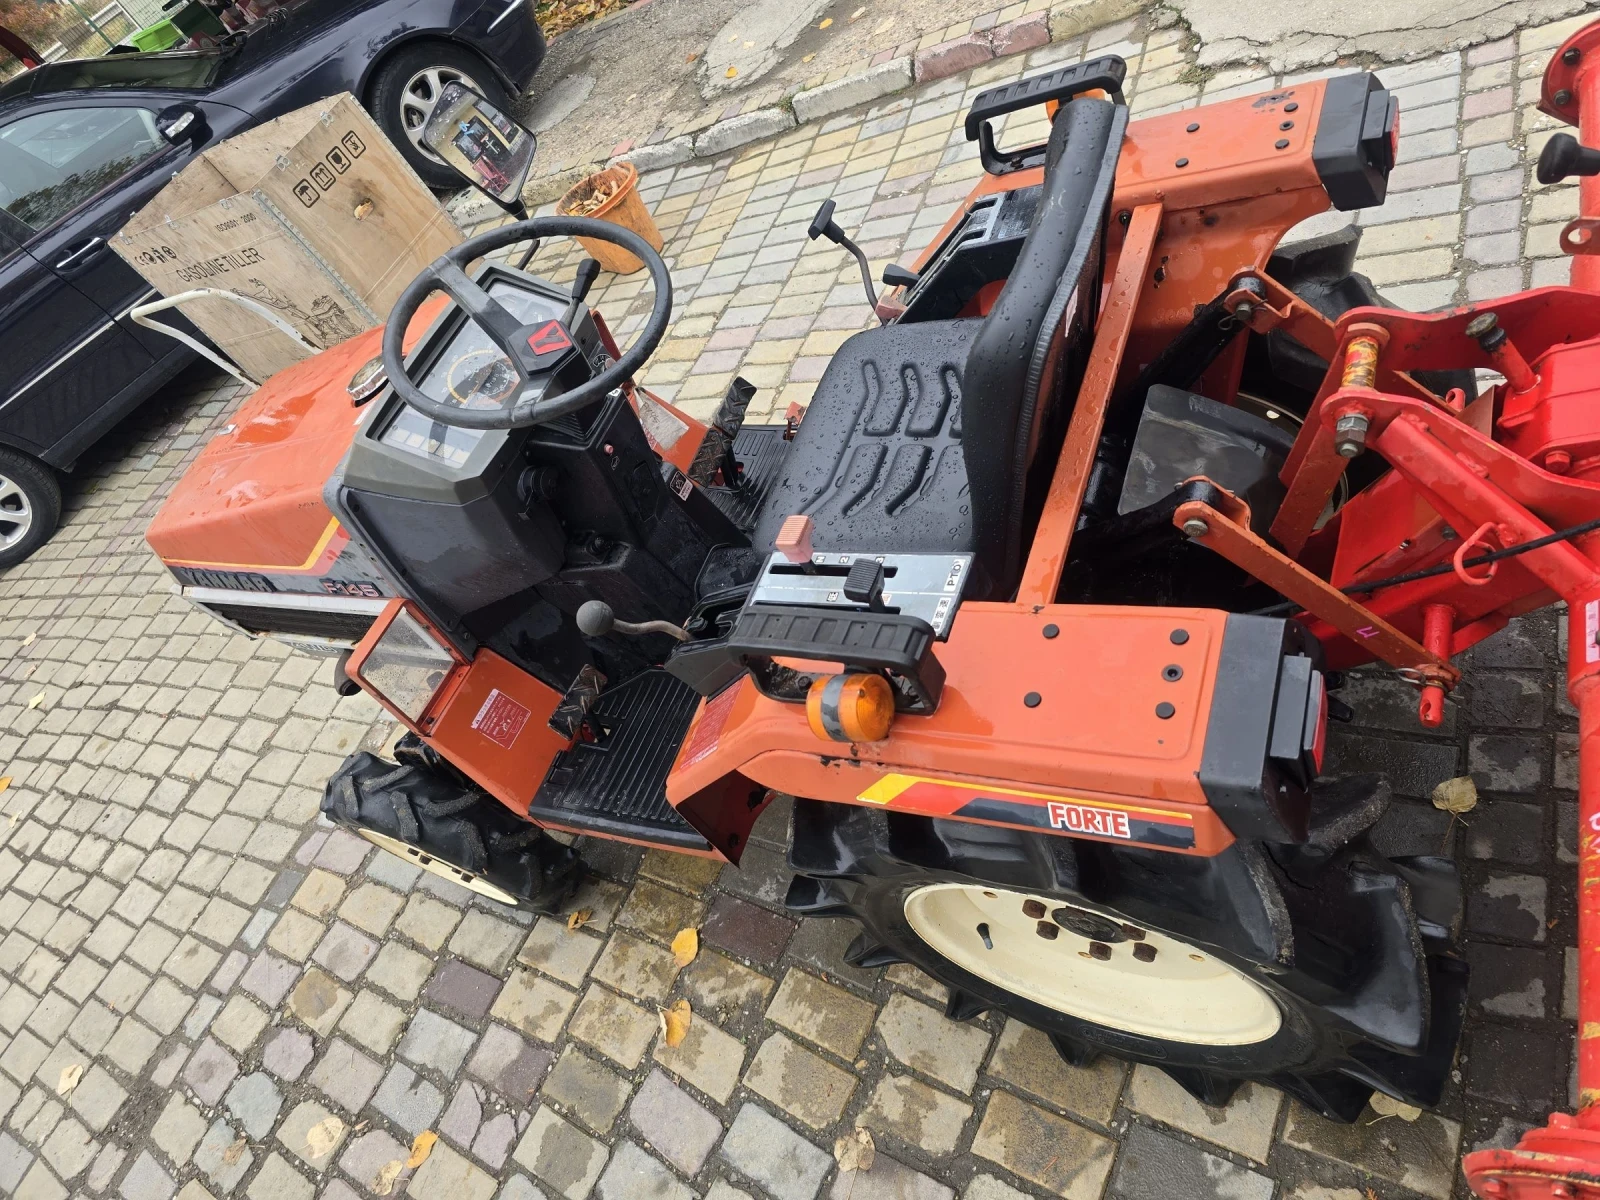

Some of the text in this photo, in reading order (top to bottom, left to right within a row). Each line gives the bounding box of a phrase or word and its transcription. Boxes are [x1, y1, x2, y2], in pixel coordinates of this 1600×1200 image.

[176, 248, 265, 282] GASOLINE TILLER
[180, 567, 276, 592] YANMAR
[946, 562, 962, 587] PTO
[320, 578, 383, 597] F145
[1049, 803, 1129, 837] FORTE
